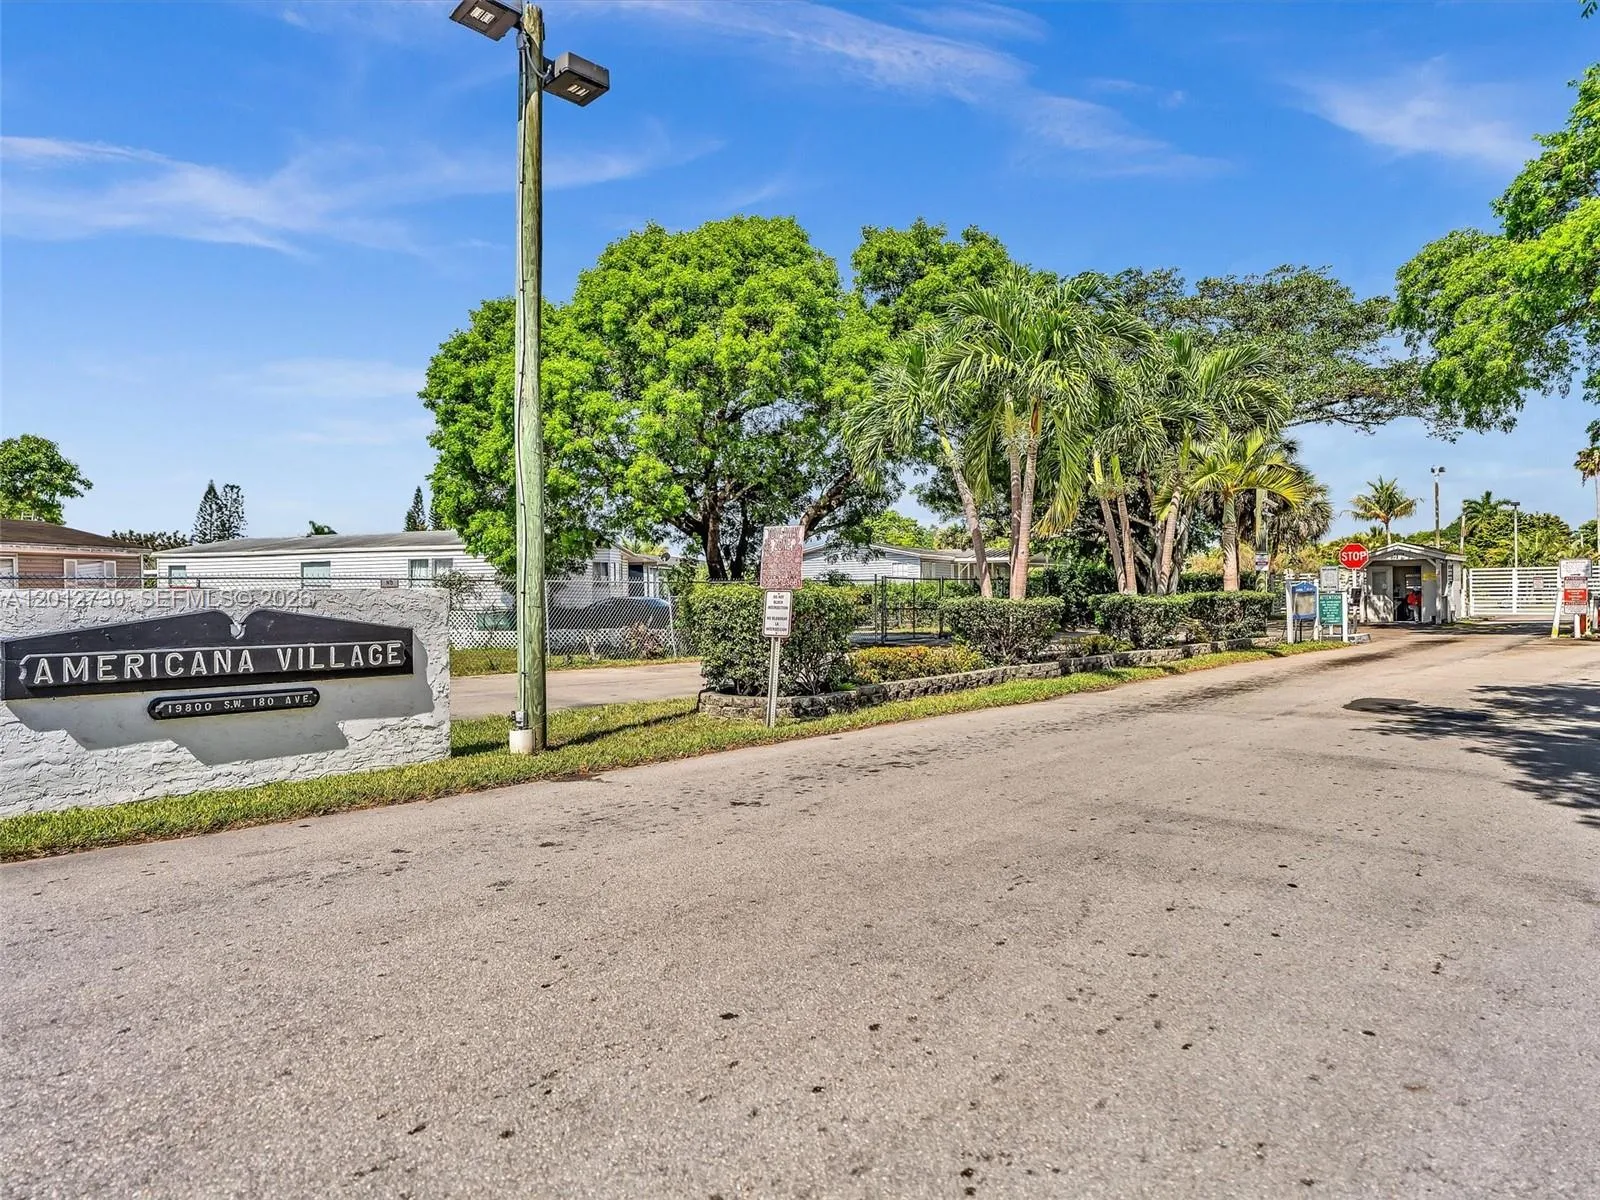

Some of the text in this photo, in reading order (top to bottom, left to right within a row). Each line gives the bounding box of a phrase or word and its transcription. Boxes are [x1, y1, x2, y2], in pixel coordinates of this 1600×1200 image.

[1341, 551, 1366, 561] STOP
[33, 642, 403, 685] AMERICANA VILLAGE
[168, 694, 312, 713] 19800 S.W. 180 AVE.
